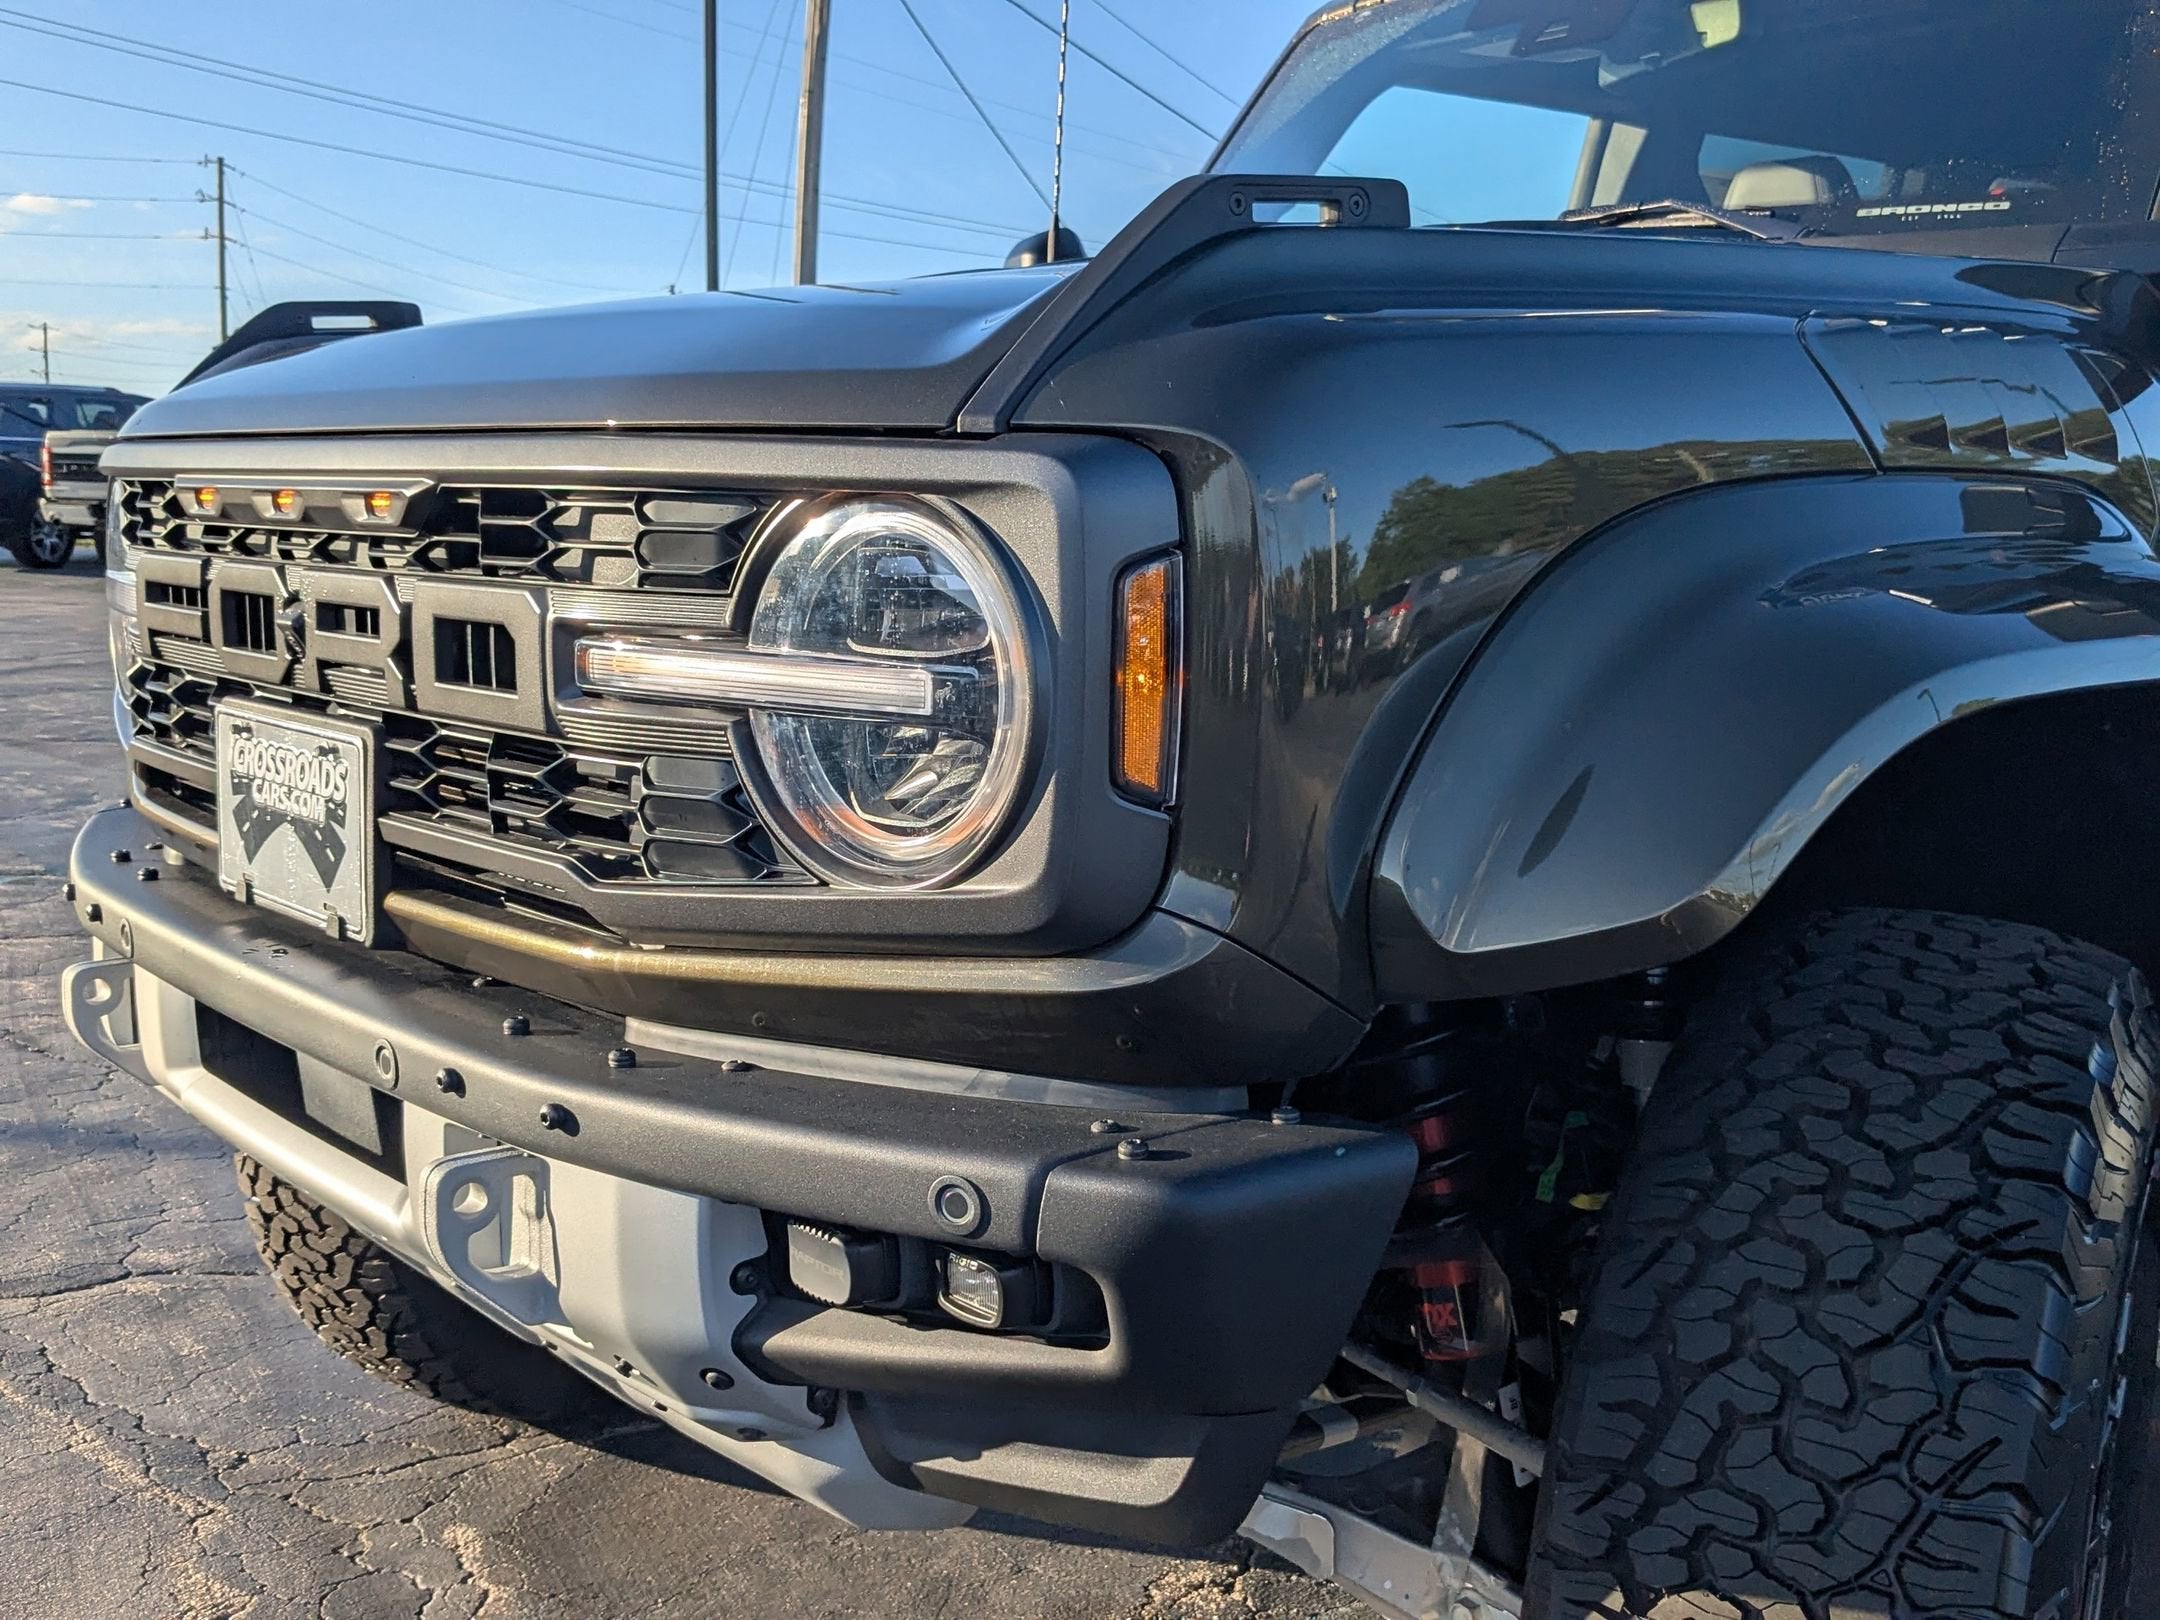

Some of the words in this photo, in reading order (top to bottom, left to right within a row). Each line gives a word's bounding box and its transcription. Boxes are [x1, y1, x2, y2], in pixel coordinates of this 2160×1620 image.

[1856, 201, 2011, 217] BRONCO
[136, 554, 545, 732] FORD
[233, 738, 348, 804] CROSSROADS
[251, 778, 326, 826] CARS.COM
